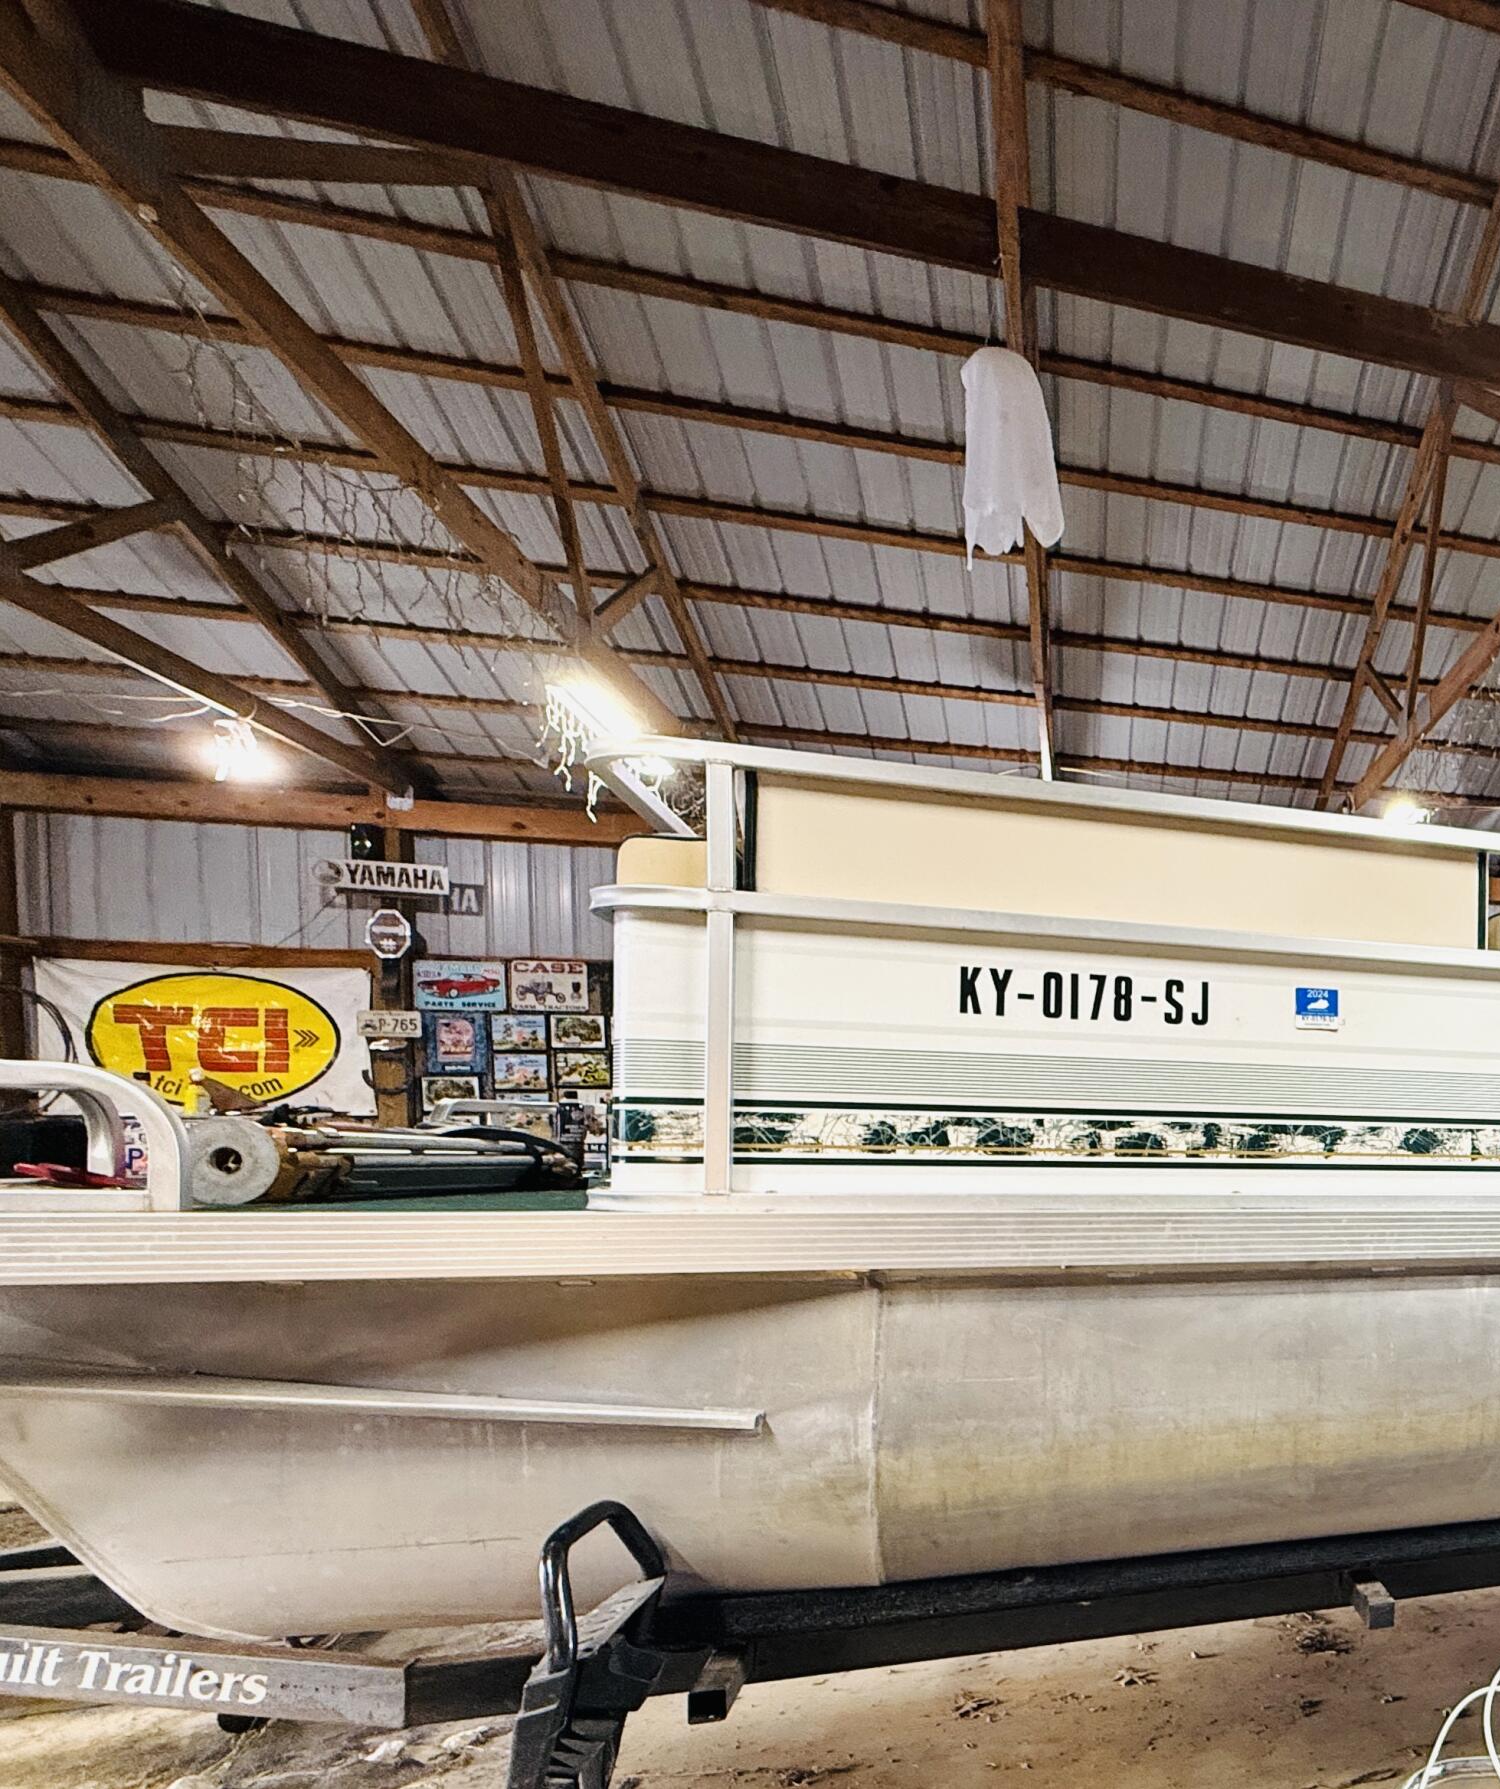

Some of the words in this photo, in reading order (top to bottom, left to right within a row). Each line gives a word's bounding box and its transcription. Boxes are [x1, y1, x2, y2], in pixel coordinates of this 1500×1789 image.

[345, 863, 444, 890] YAMAHA
[513, 962, 584, 974] CASE
[959, 966, 1210, 1026] KY-0178-SJ
[1306, 989, 1329, 998] 2024
[379, 1018, 418, 1031] P-765
[113, 1004, 290, 1073] TCI
[77, 1650, 269, 1705] Trailers
